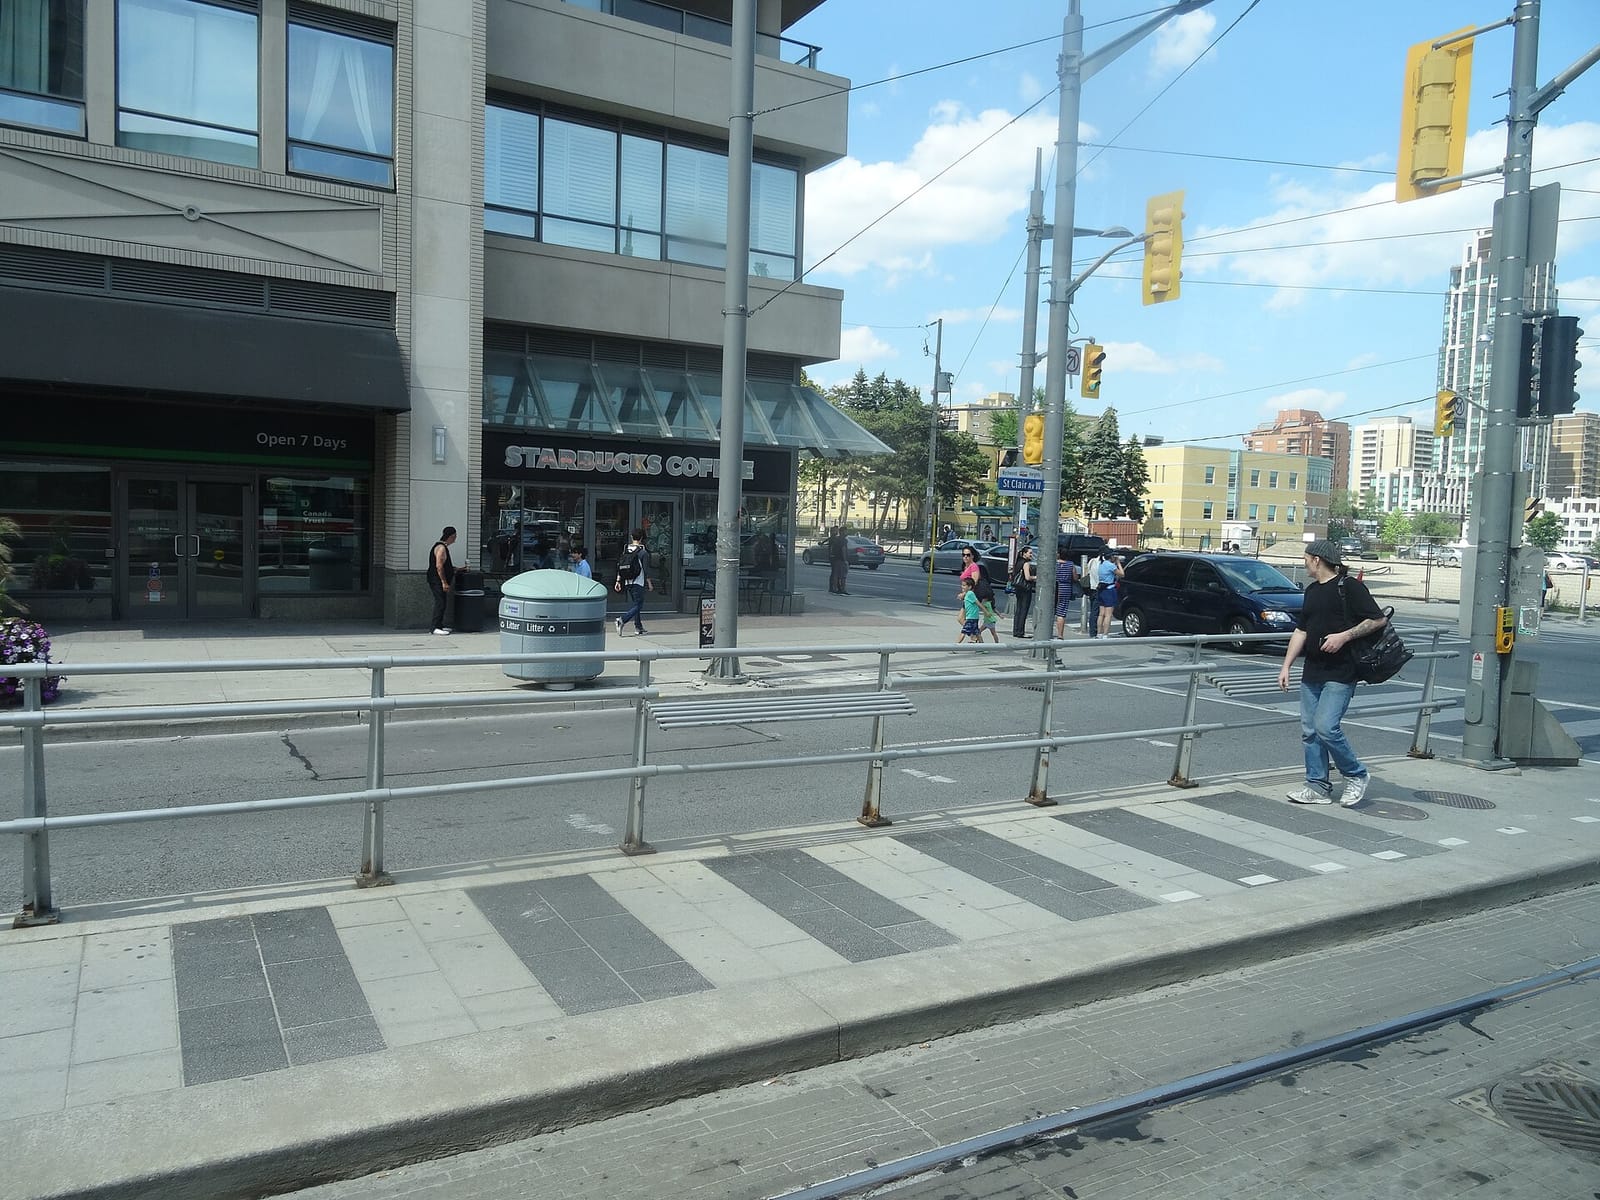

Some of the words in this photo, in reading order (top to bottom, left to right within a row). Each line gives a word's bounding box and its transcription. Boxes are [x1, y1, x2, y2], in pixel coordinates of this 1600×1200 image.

[256, 432, 295, 447] Open
[300, 434, 309, 447] 7
[313, 435, 347, 451] Days
[504, 445, 662, 475] STARBUCKS
[666, 455, 755, 480] COFFE
[1003, 479, 1010, 488] St
[1011, 480, 1027, 489] Clair
[1027, 482, 1035, 490] Av
[1035, 481, 1042, 490] W
[302, 510, 333, 518] Canada
[506, 620, 520, 630] Litter
[526, 623, 545, 632] Litter
